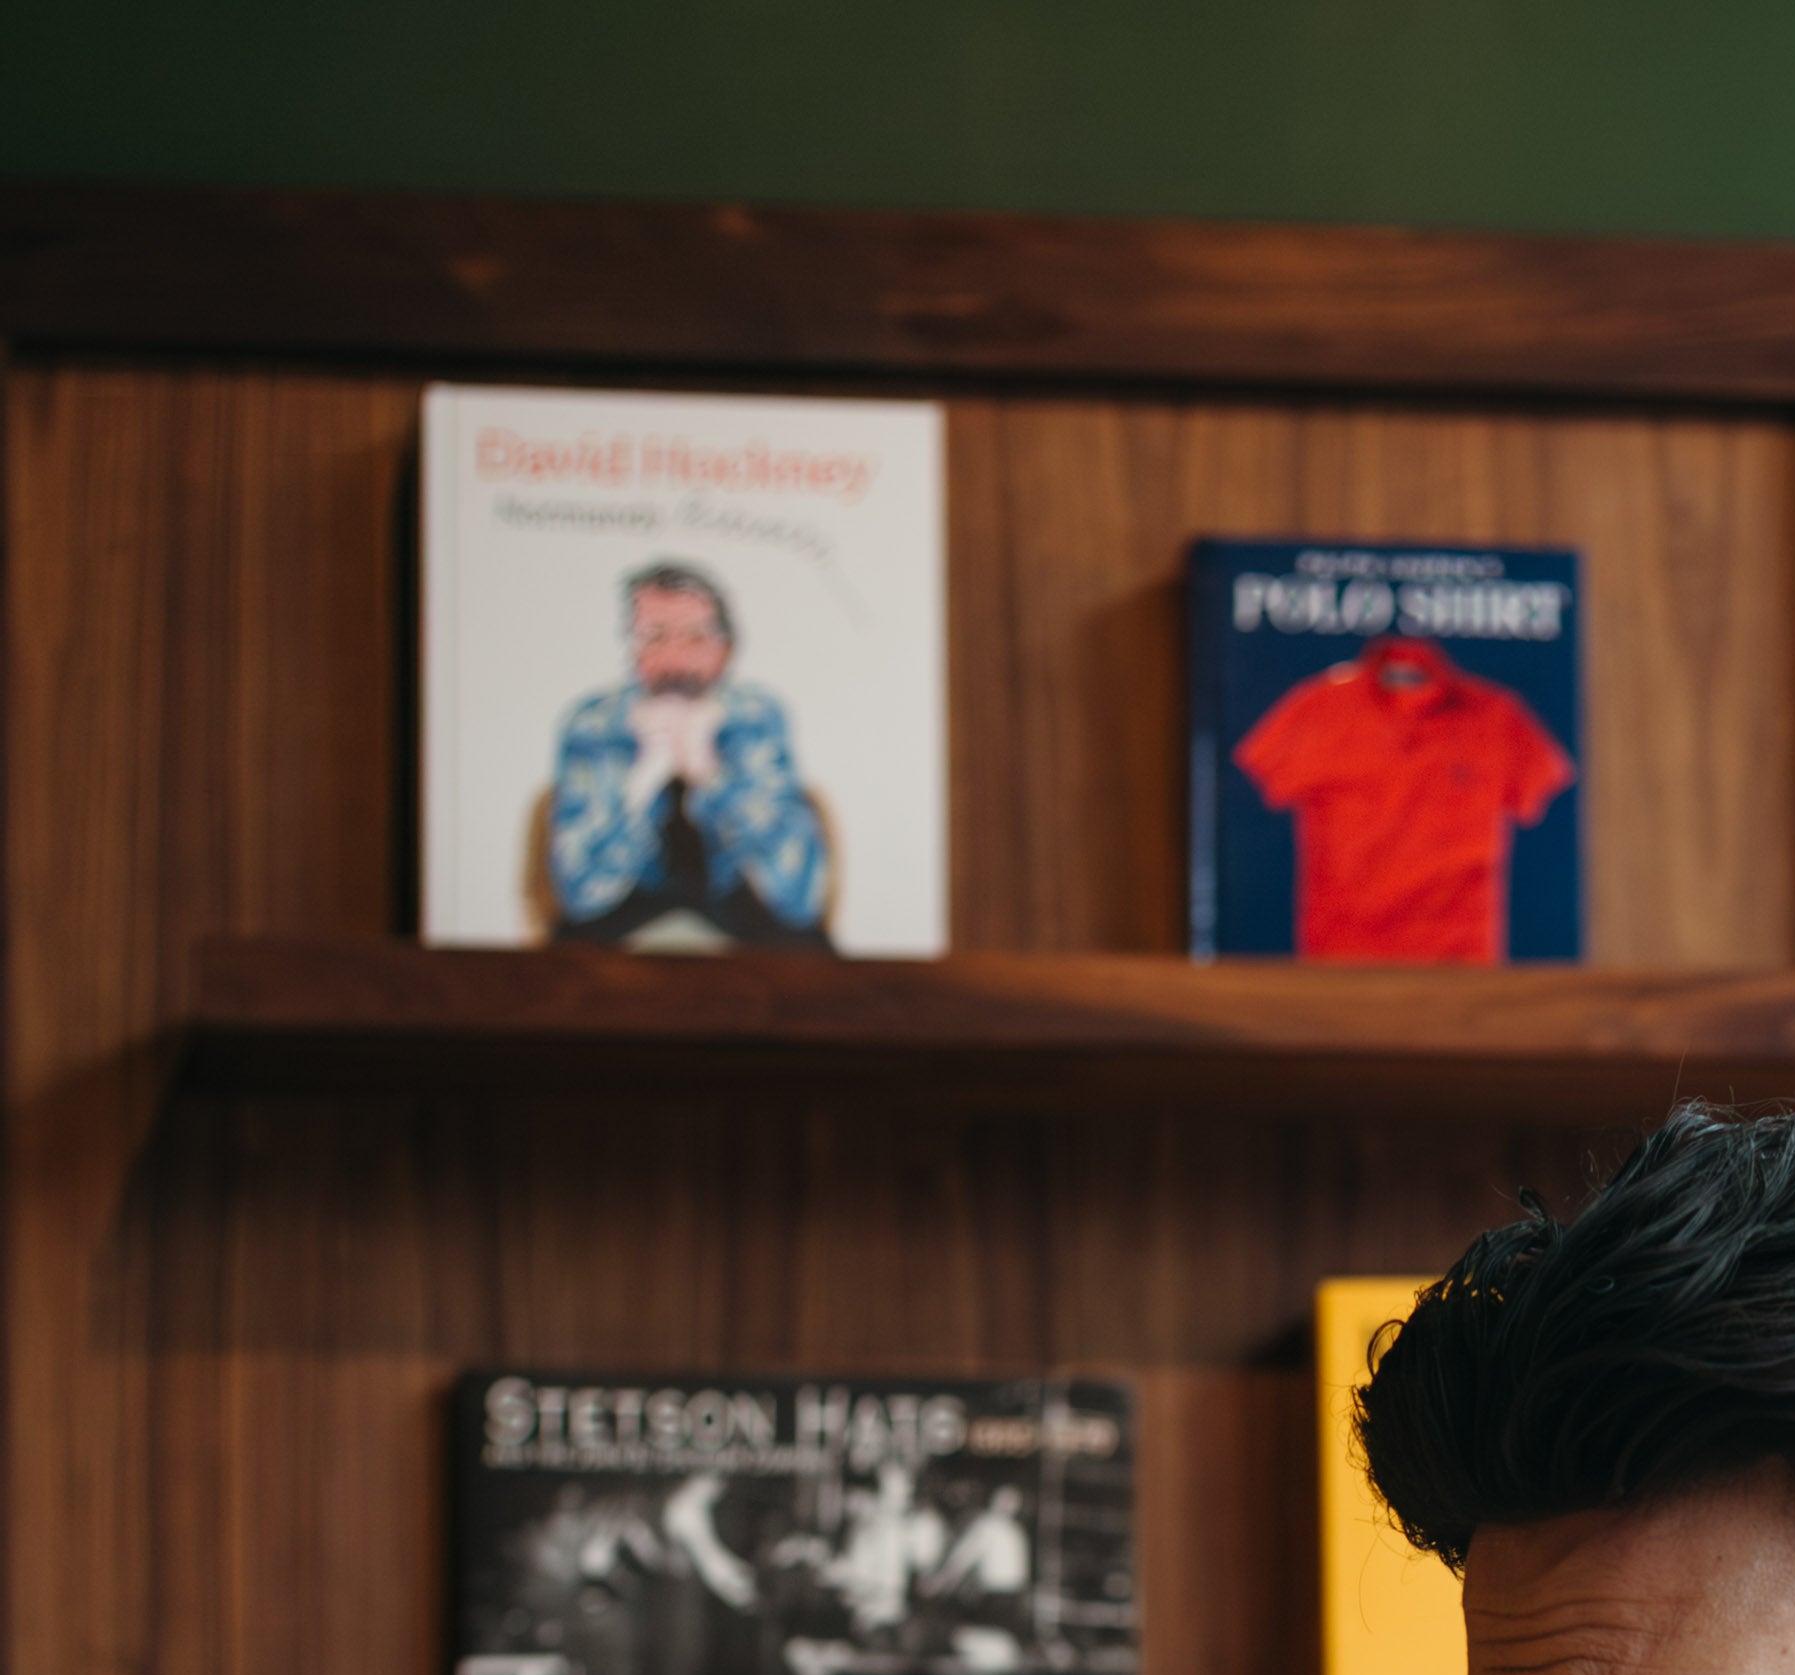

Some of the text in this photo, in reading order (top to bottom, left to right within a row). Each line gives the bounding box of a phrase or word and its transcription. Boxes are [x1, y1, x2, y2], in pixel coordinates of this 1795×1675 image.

[1233, 572, 1571, 641] POLO SHIRT
[484, 1378, 777, 1454] STETSON
[795, 1385, 966, 1457] HATS
